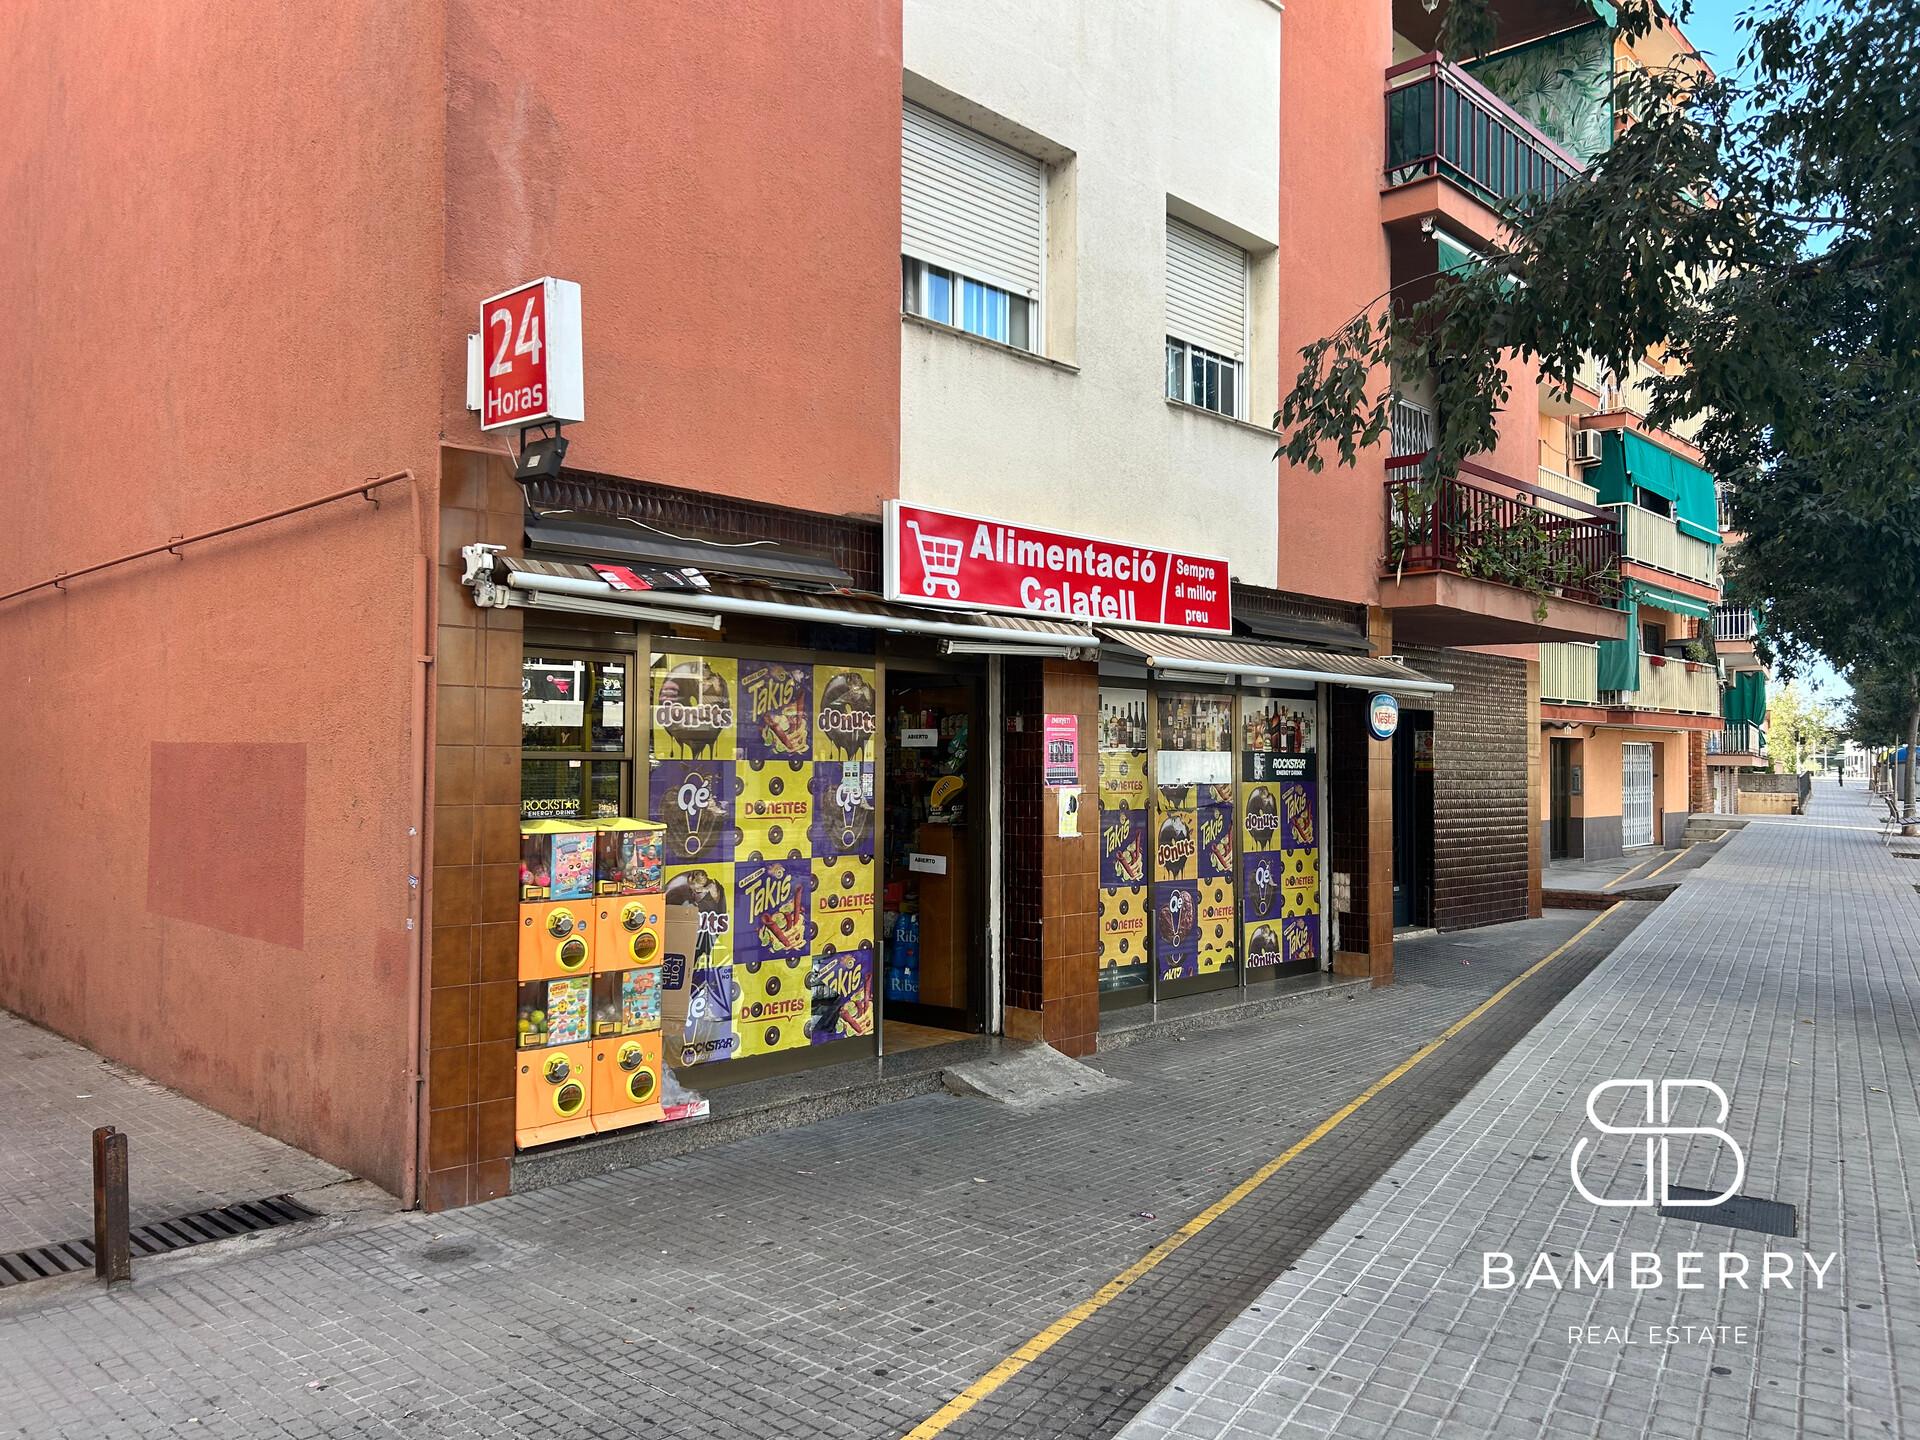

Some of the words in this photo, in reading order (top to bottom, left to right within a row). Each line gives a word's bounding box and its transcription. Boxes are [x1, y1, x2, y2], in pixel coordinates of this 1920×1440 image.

[489, 296, 543, 378] 24
[488, 383, 543, 419] Horas
[969, 524, 1156, 584] Alimentació
[1176, 559, 1216, 581] Sempre
[1020, 577, 1136, 622] Calafell
[1175, 583, 1185, 599] al
[1187, 586, 1217, 603] millor
[1185, 608, 1209, 626] preu
[656, 701, 732, 729] donuts
[523, 798, 580, 811] ROCKSTAR
[527, 809, 553, 817] ENERGY
[1245, 812, 1279, 831] donuts
[914, 856, 936, 865] ABIERTO
[1157, 839, 1196, 867] donuts
[670, 957, 684, 985] Font
